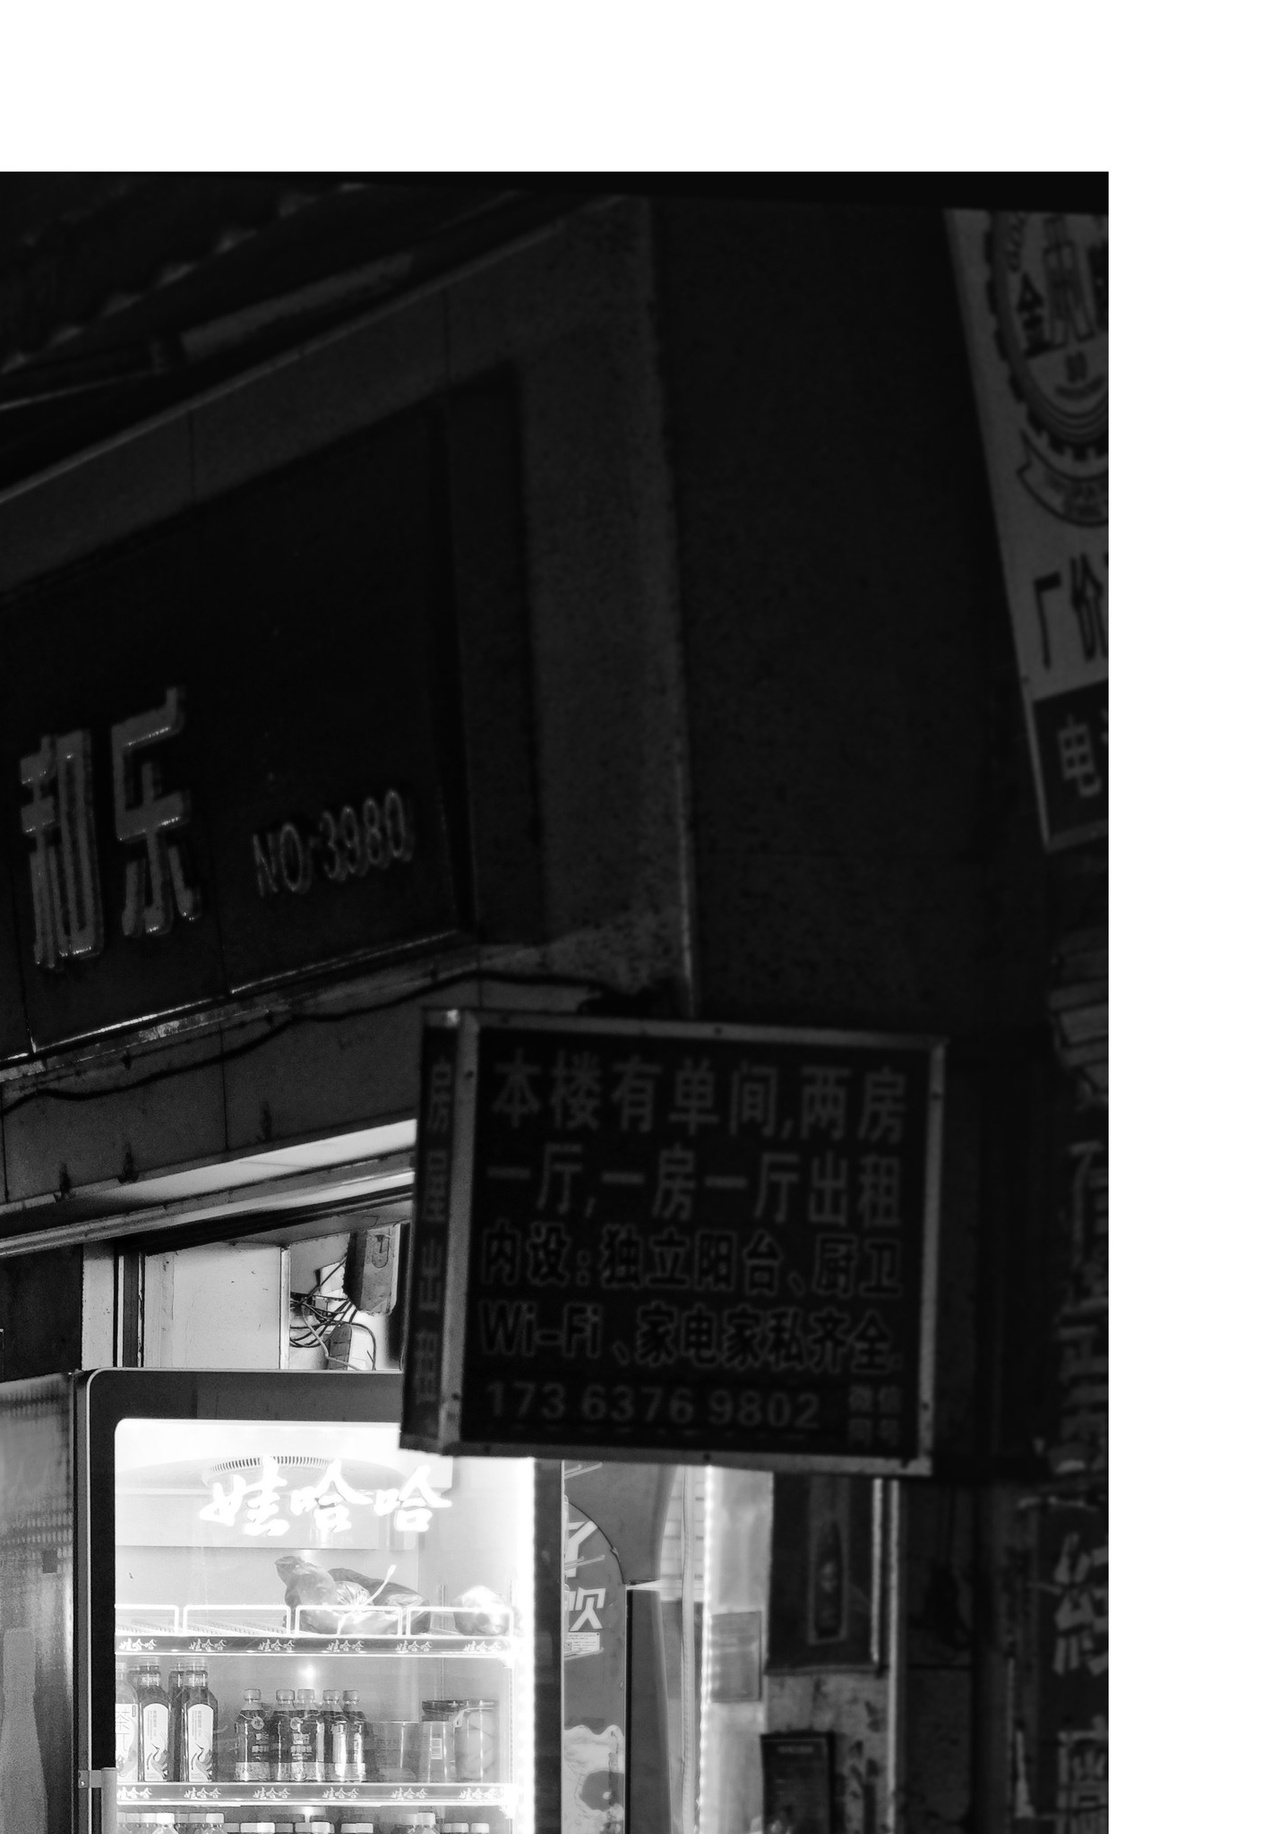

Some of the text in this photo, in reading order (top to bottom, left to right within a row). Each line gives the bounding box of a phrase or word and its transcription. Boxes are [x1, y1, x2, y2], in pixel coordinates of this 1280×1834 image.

[1056, 712, 1108, 799] 电
[19, 685, 203, 971] 和乐
[484, 1140, 904, 1229] 一厅,一房一厅出租
[485, 1381, 820, 1430] 173 6376 9802
[199, 1455, 453, 1536] 娃哈哈
